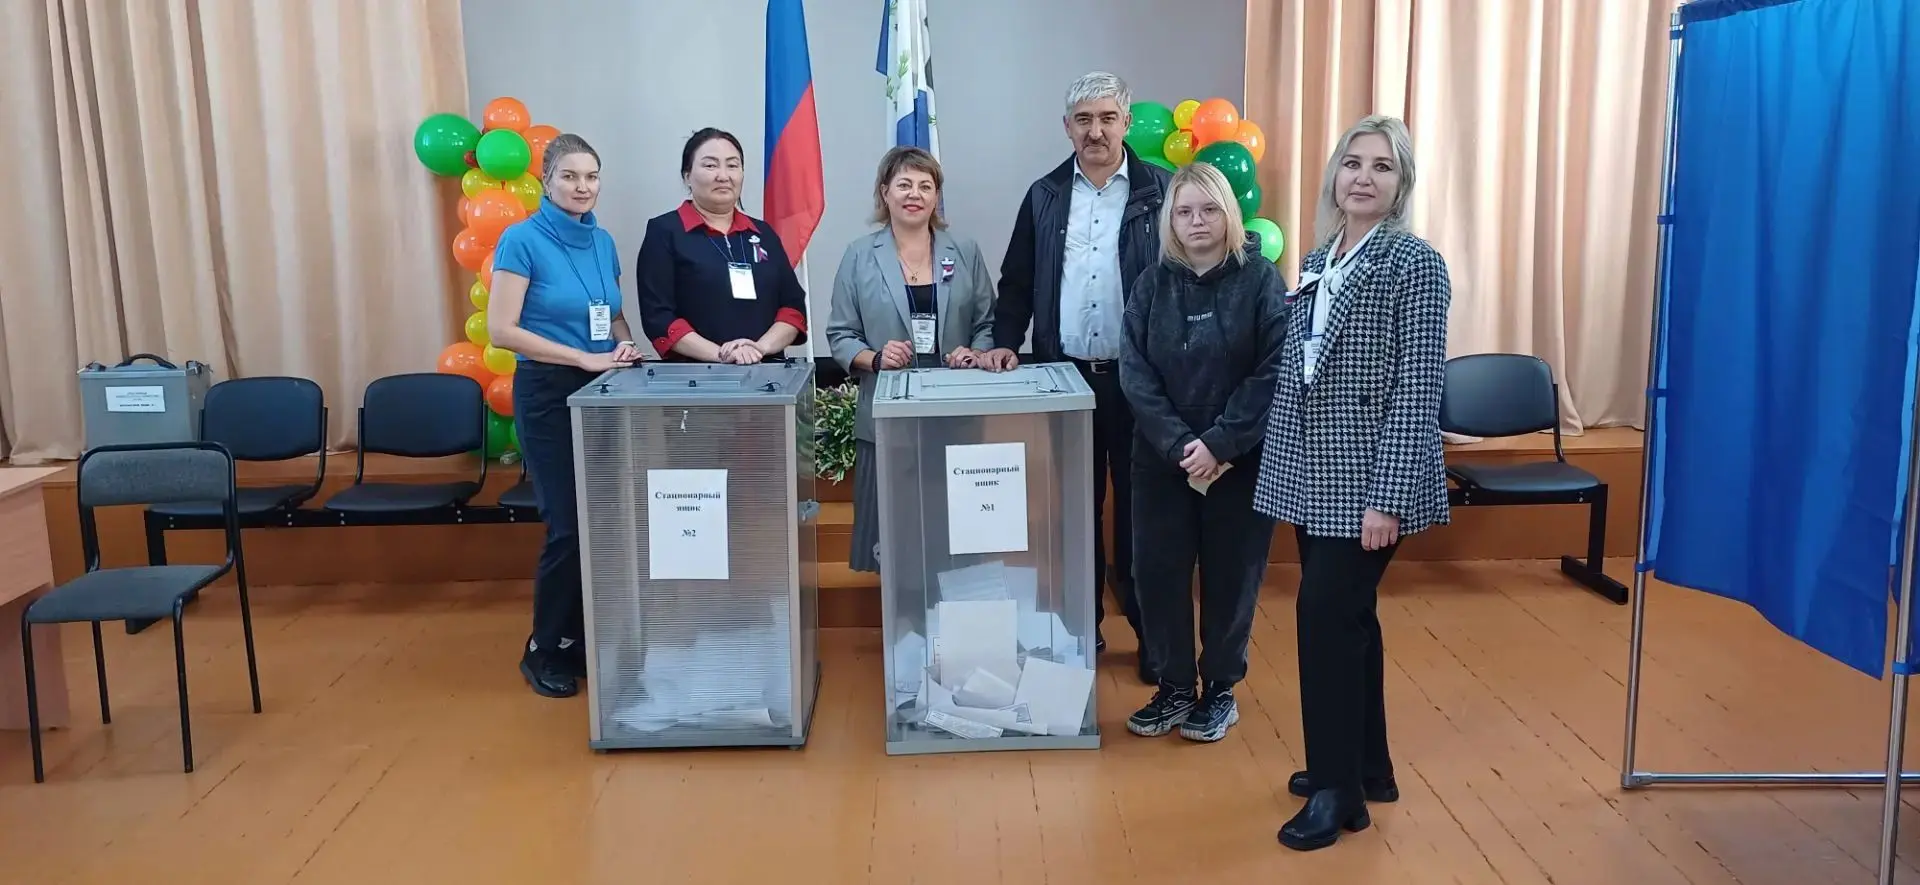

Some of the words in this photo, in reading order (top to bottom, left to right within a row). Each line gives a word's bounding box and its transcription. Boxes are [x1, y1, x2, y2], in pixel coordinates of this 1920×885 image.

[953, 465, 1020, 476] Стационарный
[974, 479, 1000, 487] ящик
[654, 491, 721, 501] Стационарный
[980, 503, 995, 511] №1
[682, 529, 697, 537] №2
